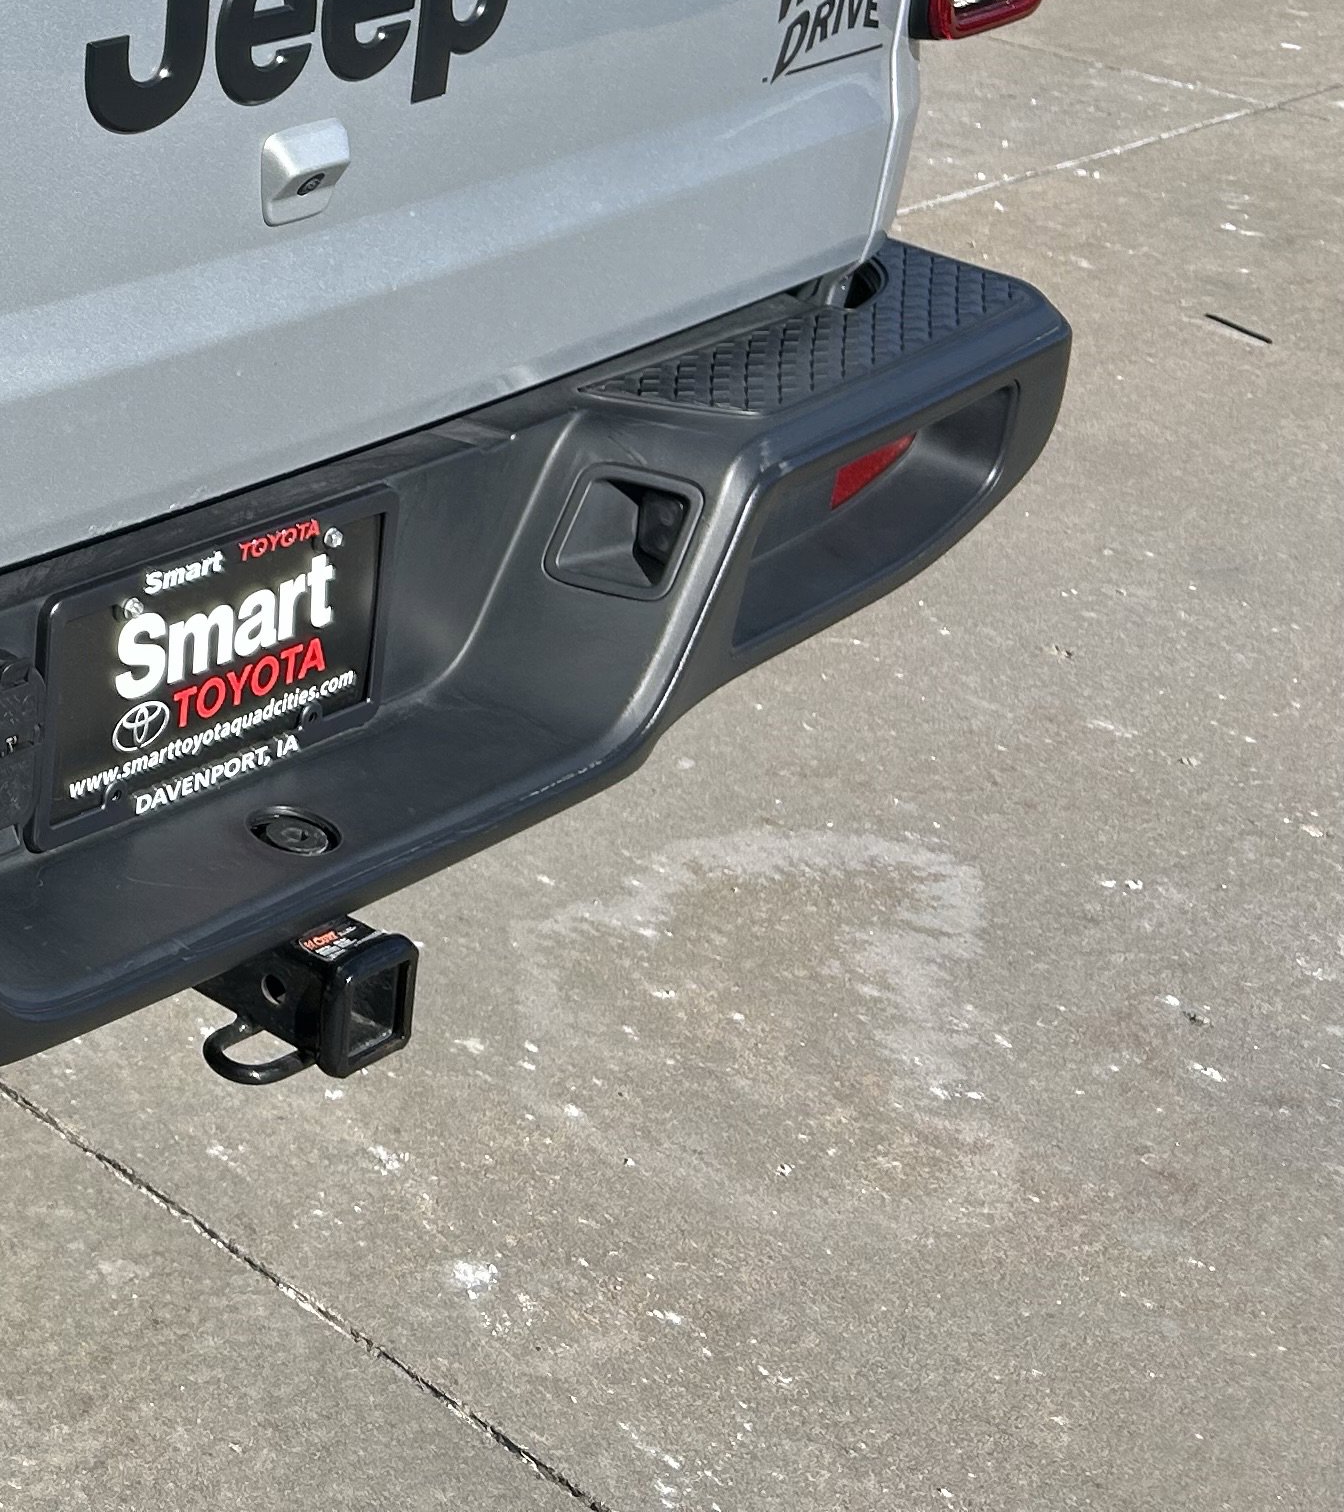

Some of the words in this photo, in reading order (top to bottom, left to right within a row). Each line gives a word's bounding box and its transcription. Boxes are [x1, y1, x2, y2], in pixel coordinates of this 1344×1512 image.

[144, 550, 225, 595] Smart
[238, 519, 321, 562] TOYOTA
[115, 553, 336, 700] Smart
[173, 637, 326, 728] TOYOTA
[69, 669, 356, 800] www.smarttoyotaquadcities.com
[133, 745, 271, 816] DAVENPORT,
[275, 735, 301, 759] IA
